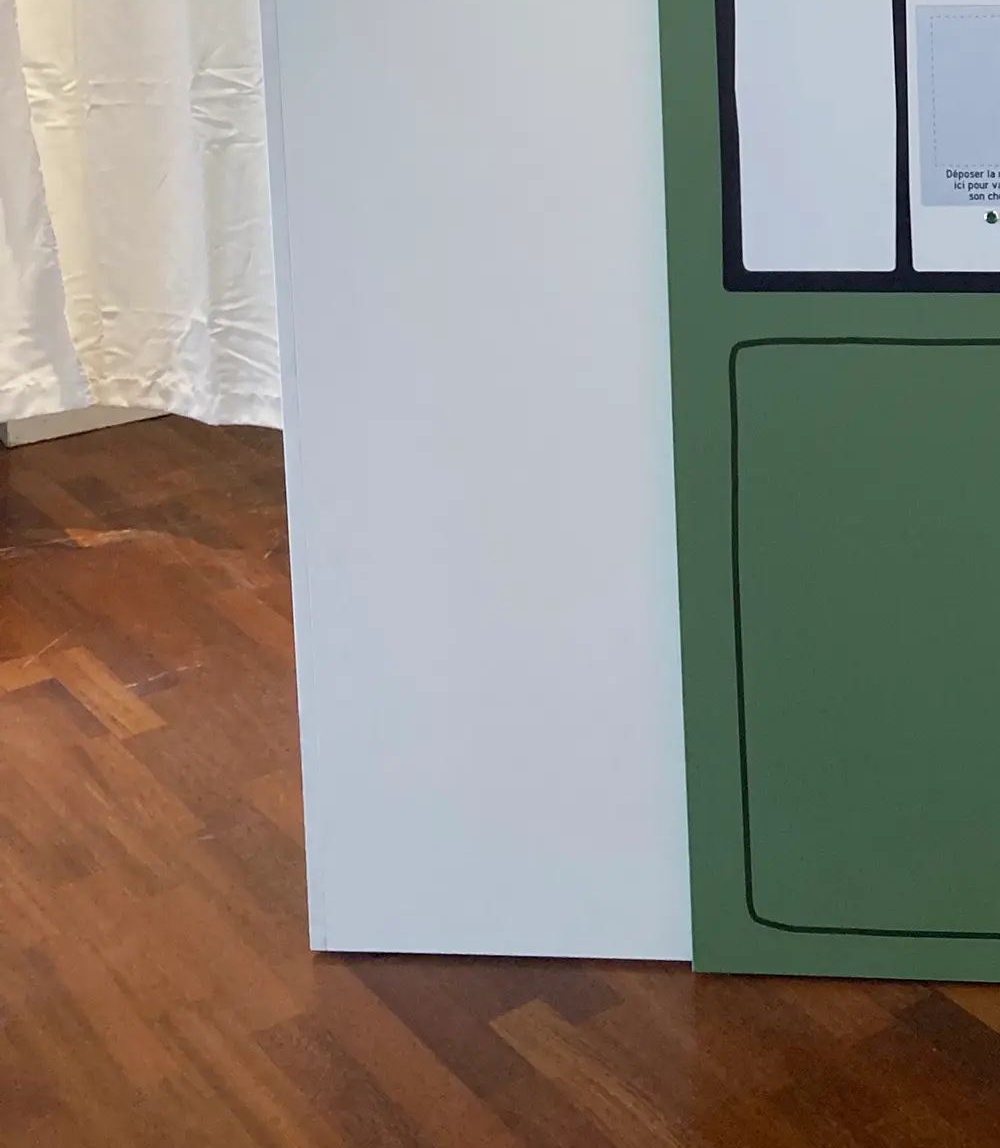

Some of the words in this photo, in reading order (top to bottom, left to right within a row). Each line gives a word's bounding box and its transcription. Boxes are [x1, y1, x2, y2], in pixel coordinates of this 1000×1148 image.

[946, 169, 984, 180] Déposer
[987, 170, 996, 179] la
[954, 181, 965, 190] ici
[968, 182, 989, 192] pour
[969, 193, 985, 201] son
